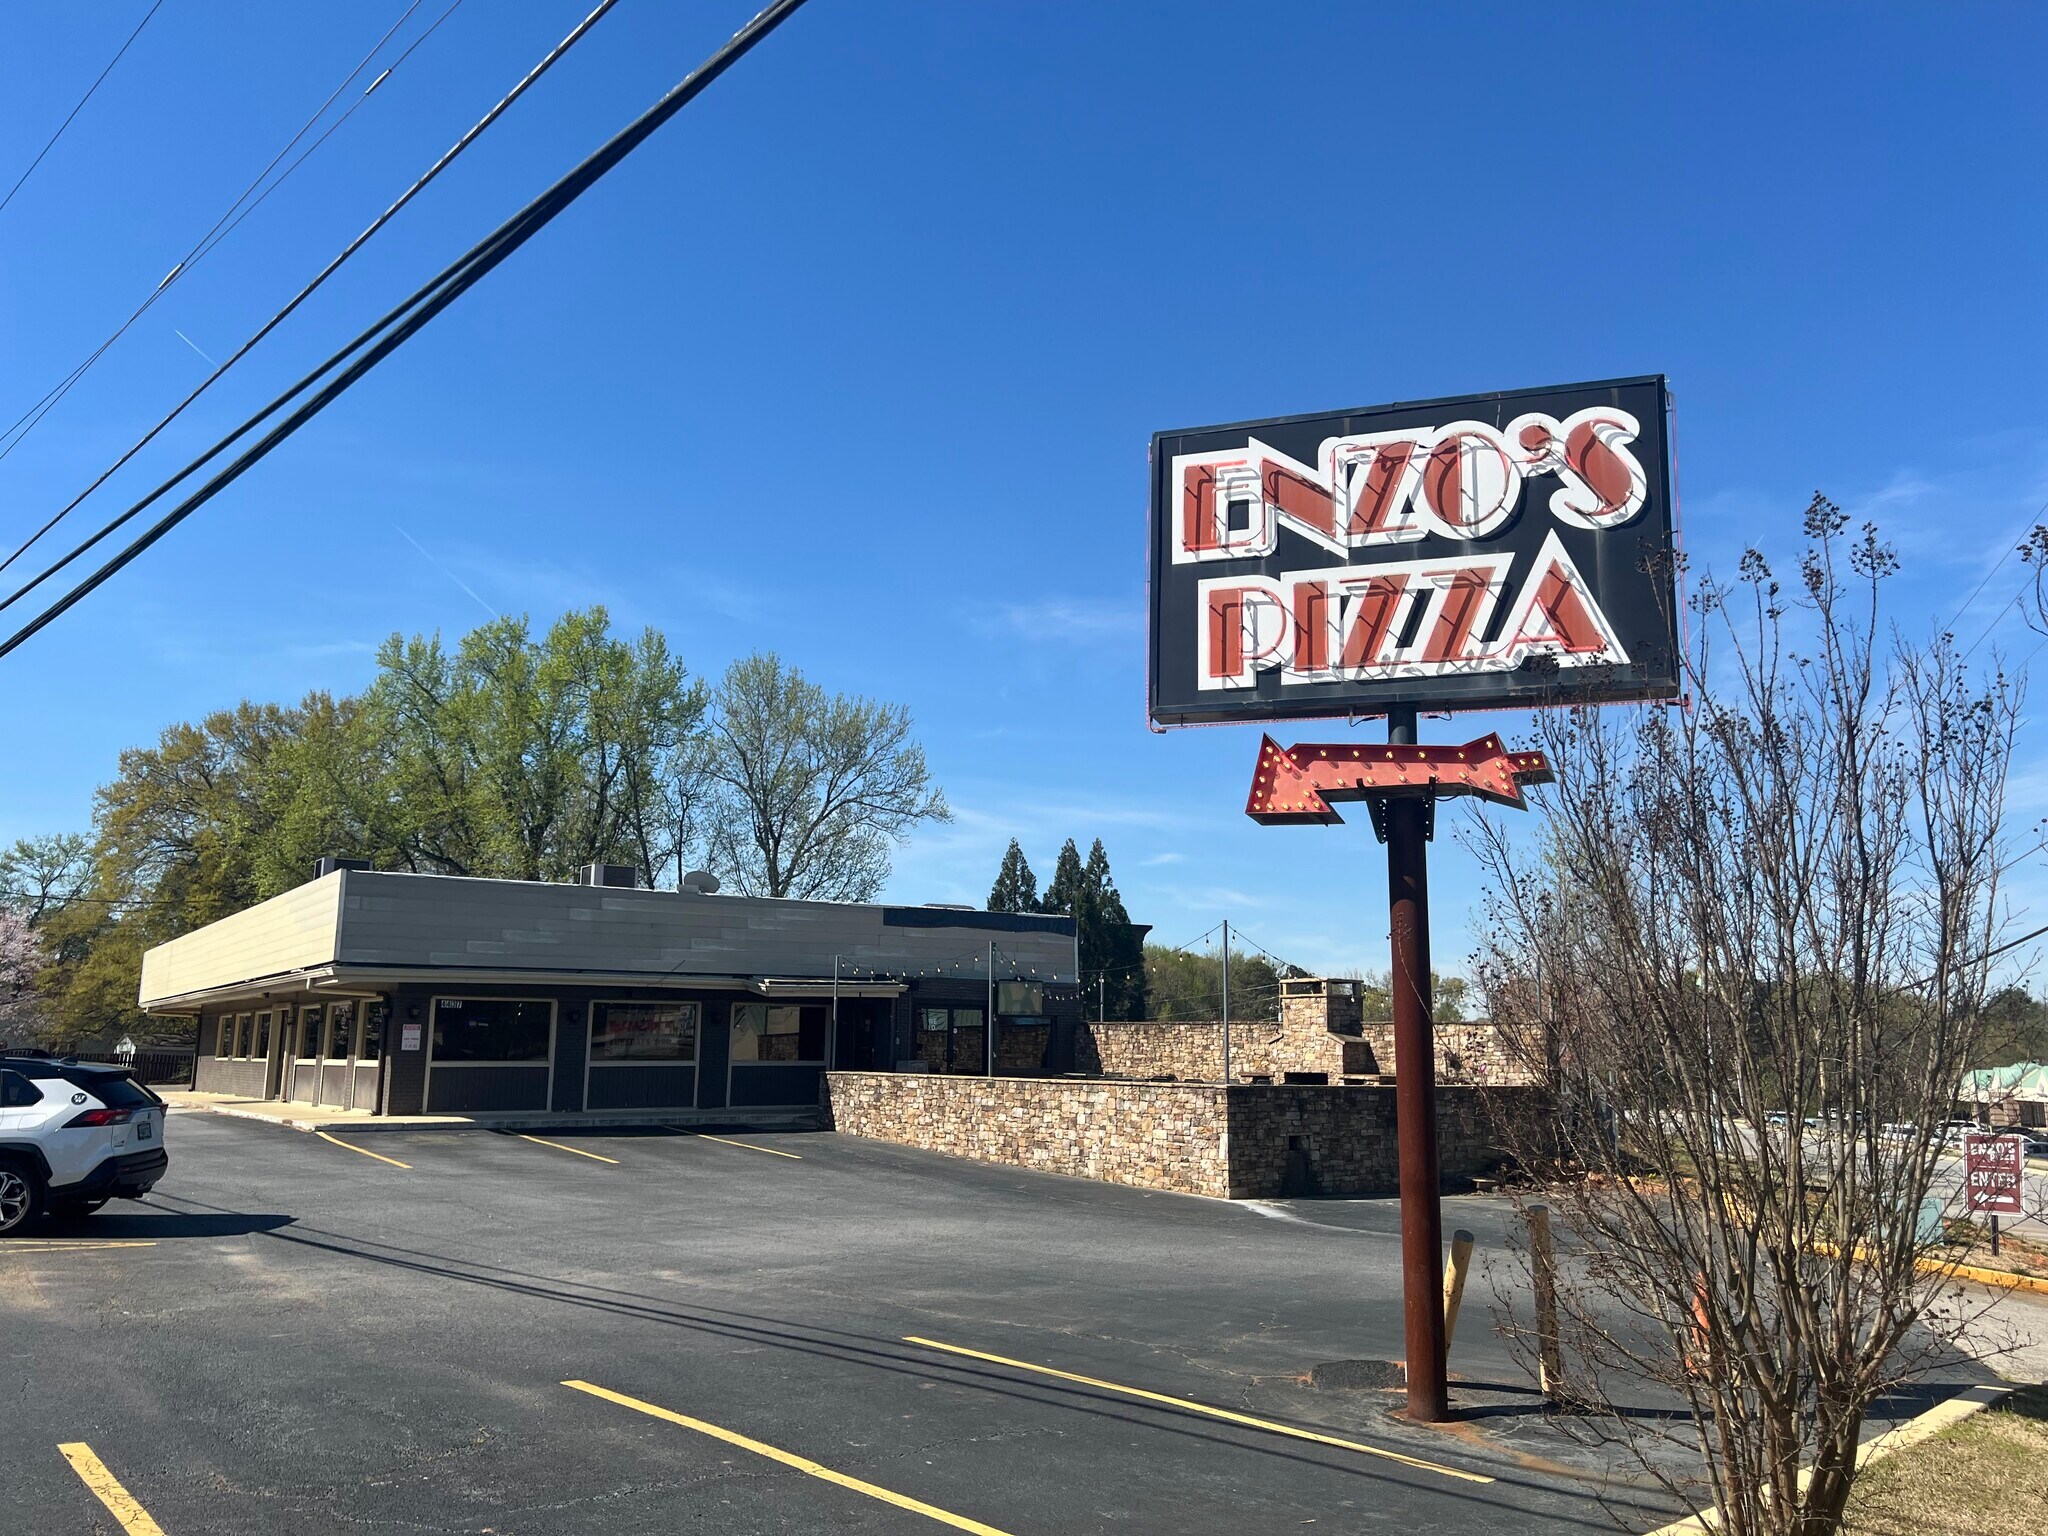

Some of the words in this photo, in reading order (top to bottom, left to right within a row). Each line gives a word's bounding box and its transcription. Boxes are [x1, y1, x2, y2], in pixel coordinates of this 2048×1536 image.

[1172, 406, 1647, 565] ENZO'S
[1198, 528, 1630, 691] PIZZA
[1970, 1142, 2016, 1155] ENZO'S
[1989, 1153, 2016, 1162] pzza
[1970, 1171, 2017, 1189] ENTER
